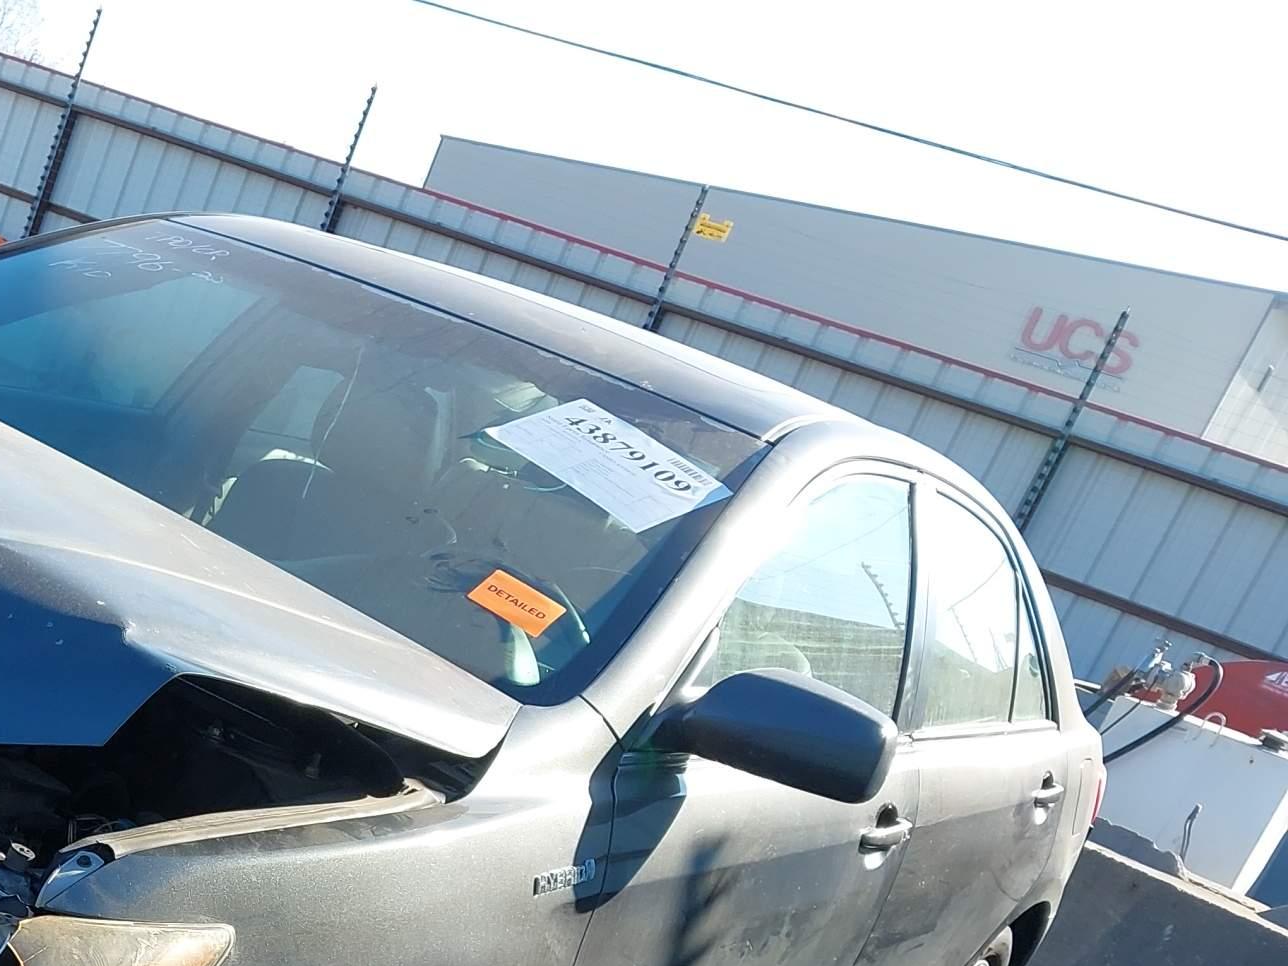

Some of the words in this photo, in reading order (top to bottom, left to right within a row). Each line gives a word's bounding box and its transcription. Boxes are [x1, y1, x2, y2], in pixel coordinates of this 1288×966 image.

[1020, 306, 1140, 375] UCS
[565, 415, 693, 493] 43879109
[487, 584, 547, 621] DETAILED
